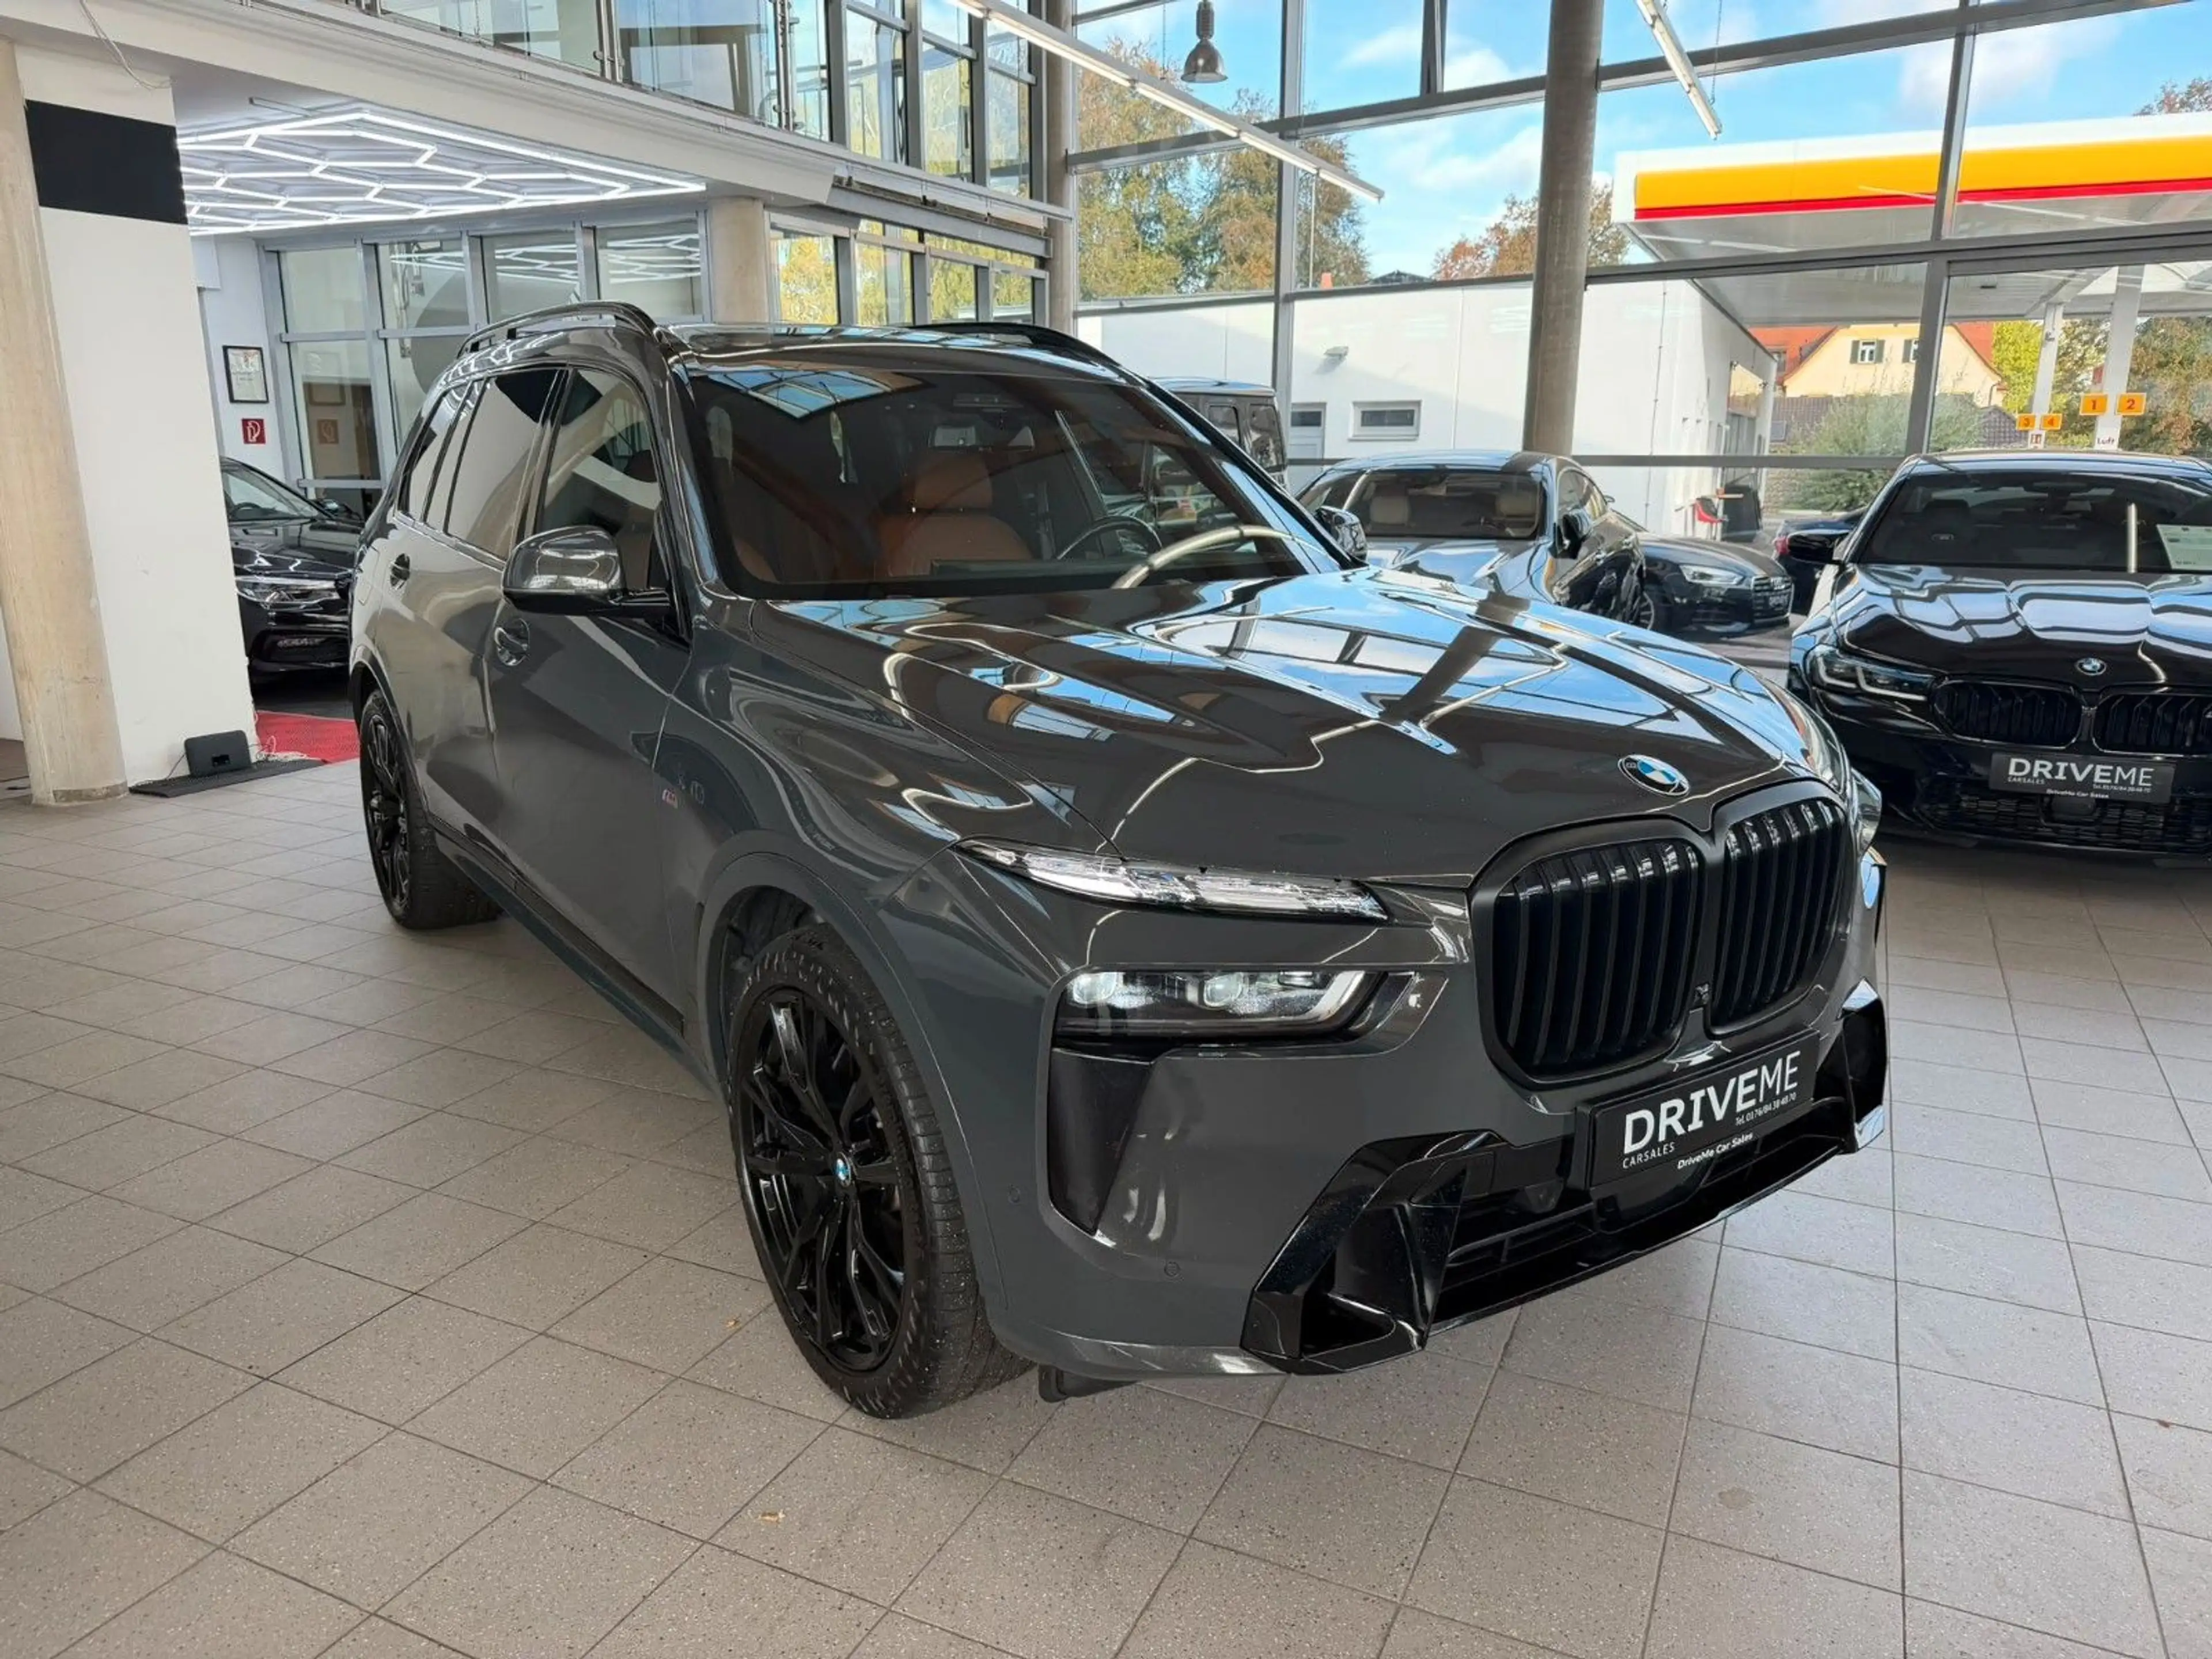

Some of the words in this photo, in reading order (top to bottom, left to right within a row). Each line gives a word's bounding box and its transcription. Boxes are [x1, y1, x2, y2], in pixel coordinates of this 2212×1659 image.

[2092, 399, 2097, 410] 1
[2126, 398, 2135, 410] 2
[2009, 757, 2154, 786] DRIVEME
[1624, 1050, 1801, 1154] DRIVEME
[1622, 1142, 1675, 1169] CARSALES
[1677, 1149, 1714, 1169] DriveMe
[1716, 1142, 1731, 1153] Car
[1732, 1132, 1753, 1147] Sales
